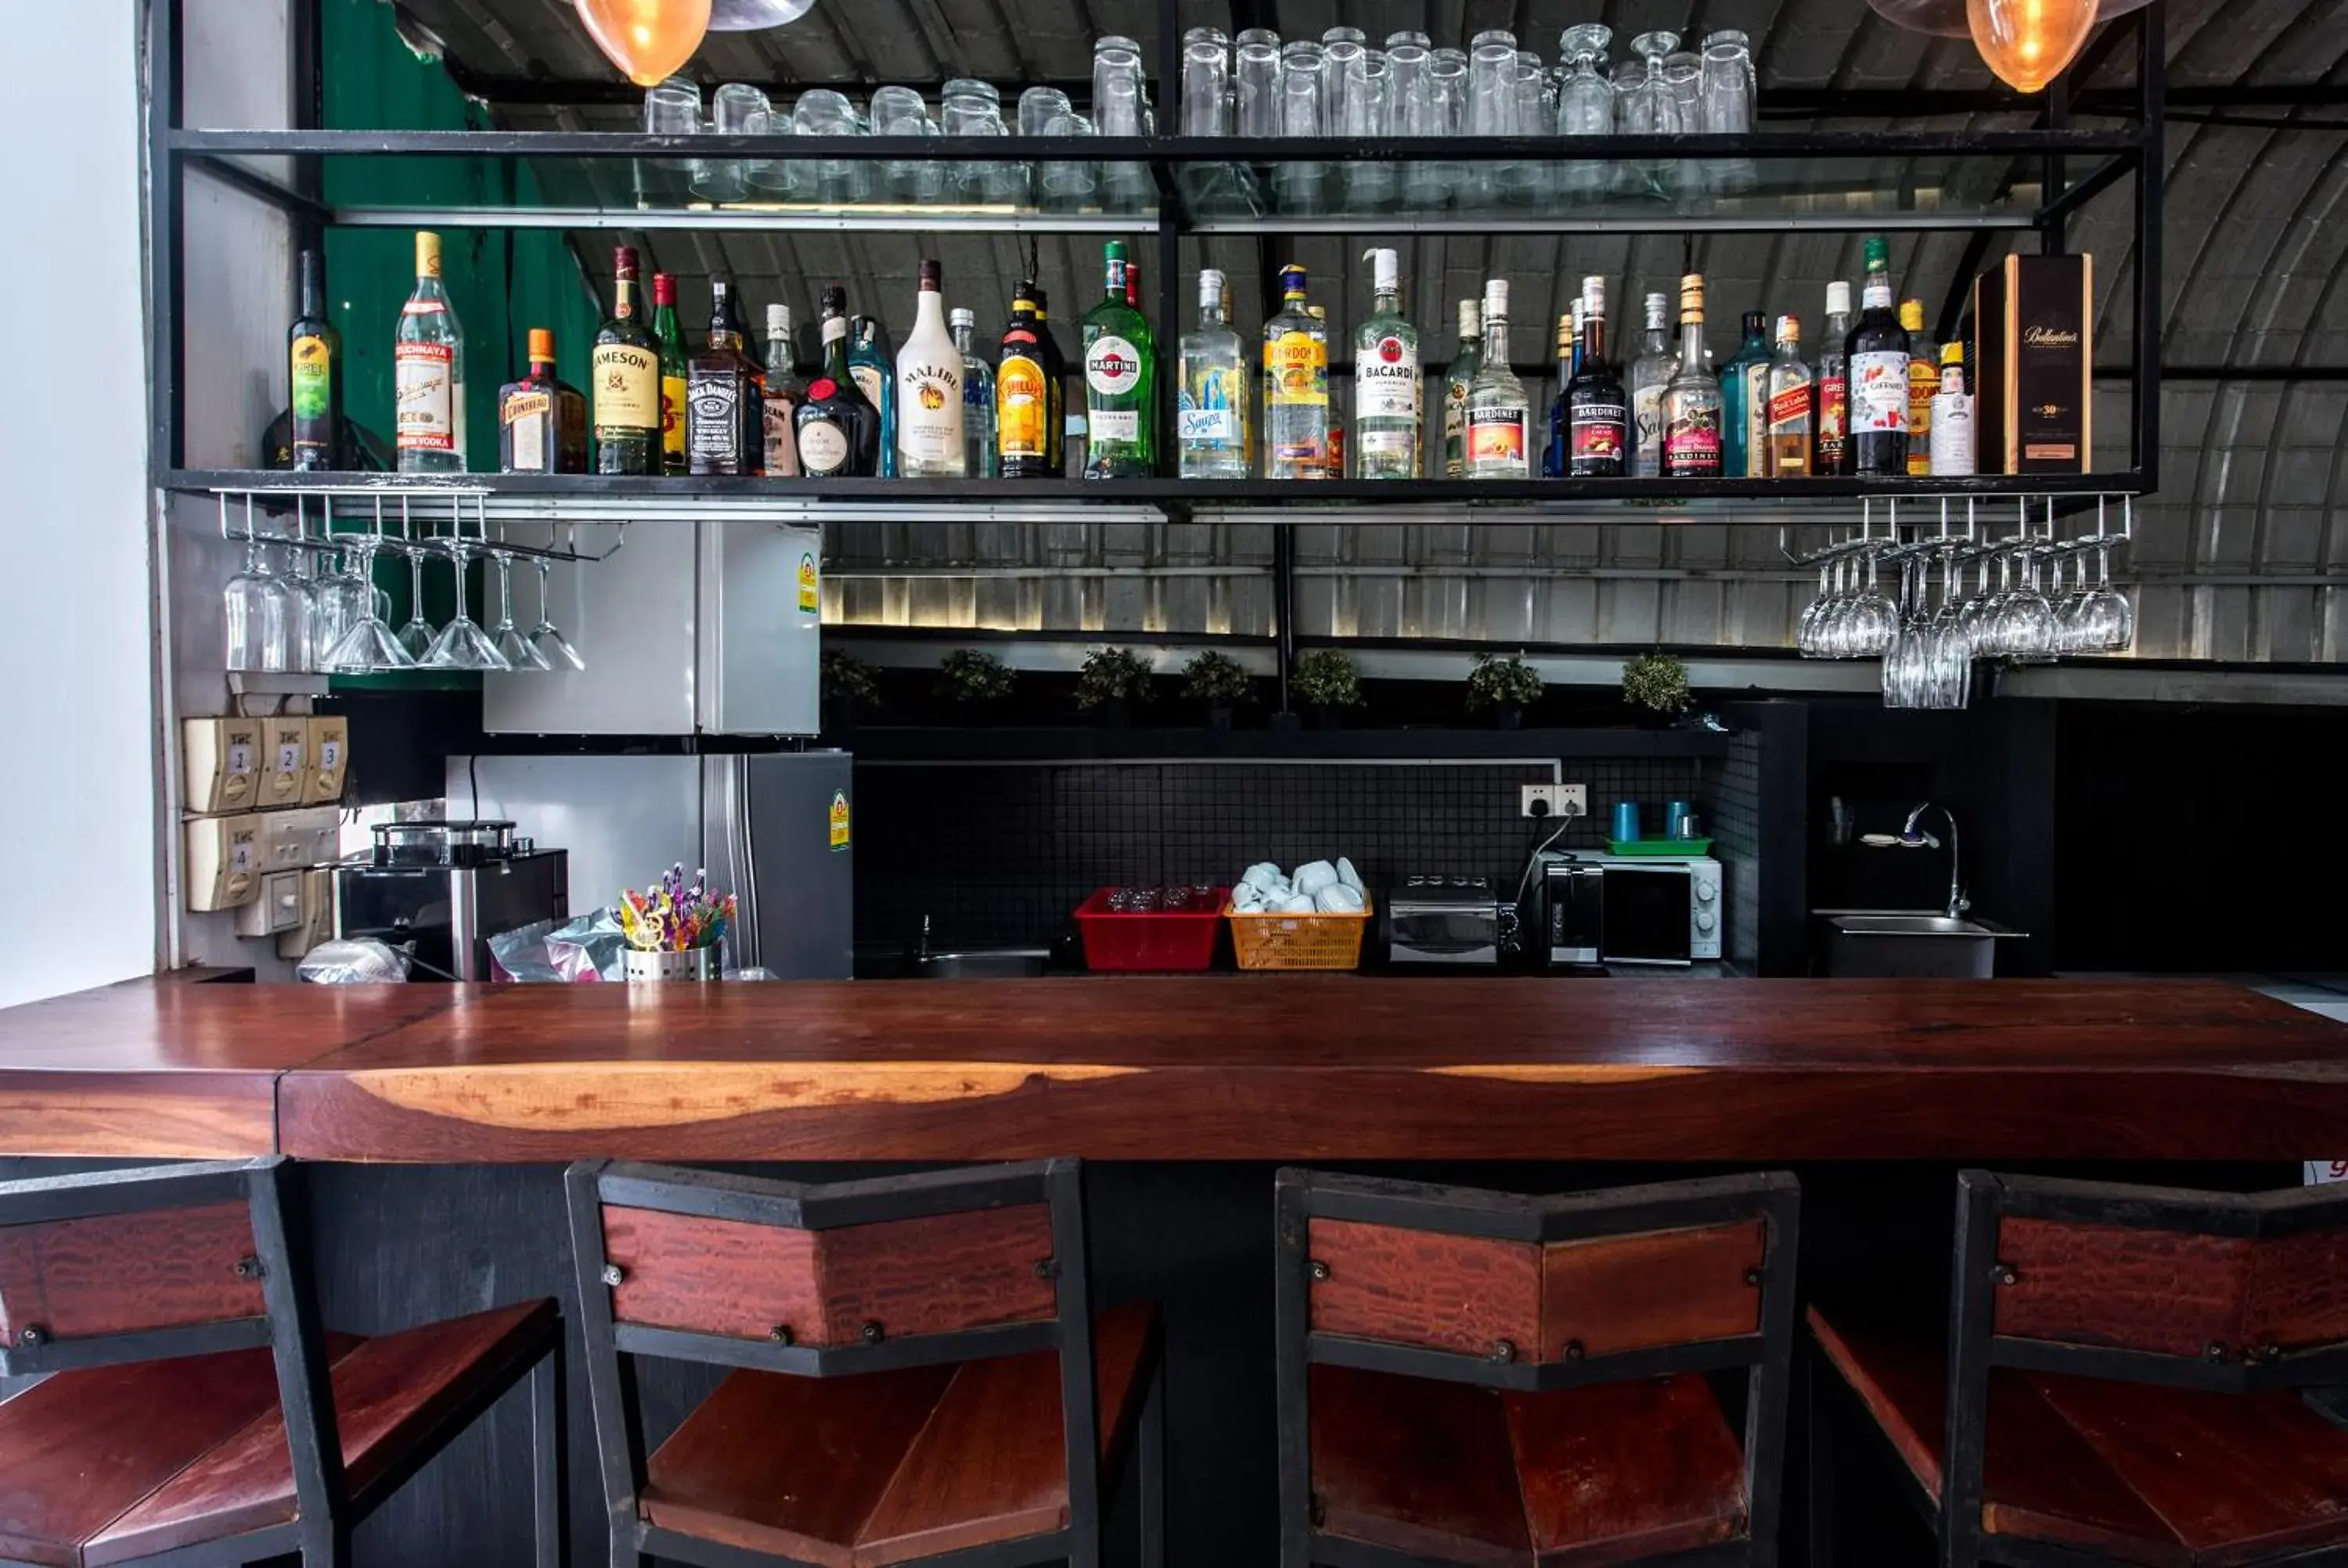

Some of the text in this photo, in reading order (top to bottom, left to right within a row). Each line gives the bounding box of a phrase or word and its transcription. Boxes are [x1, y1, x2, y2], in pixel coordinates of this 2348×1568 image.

[1089, 360, 1136, 372] MARTINI
[904, 365, 959, 390] MALIBU
[1773, 391, 1810, 412] Red Label
[1578, 408, 1622, 418] BARDINET
[1822, 441, 1845, 451] BAR
[237, 752, 244, 769] 1
[284, 751, 294, 767] 2
[326, 749, 335, 764] 3
[237, 851, 246, 865] 4
